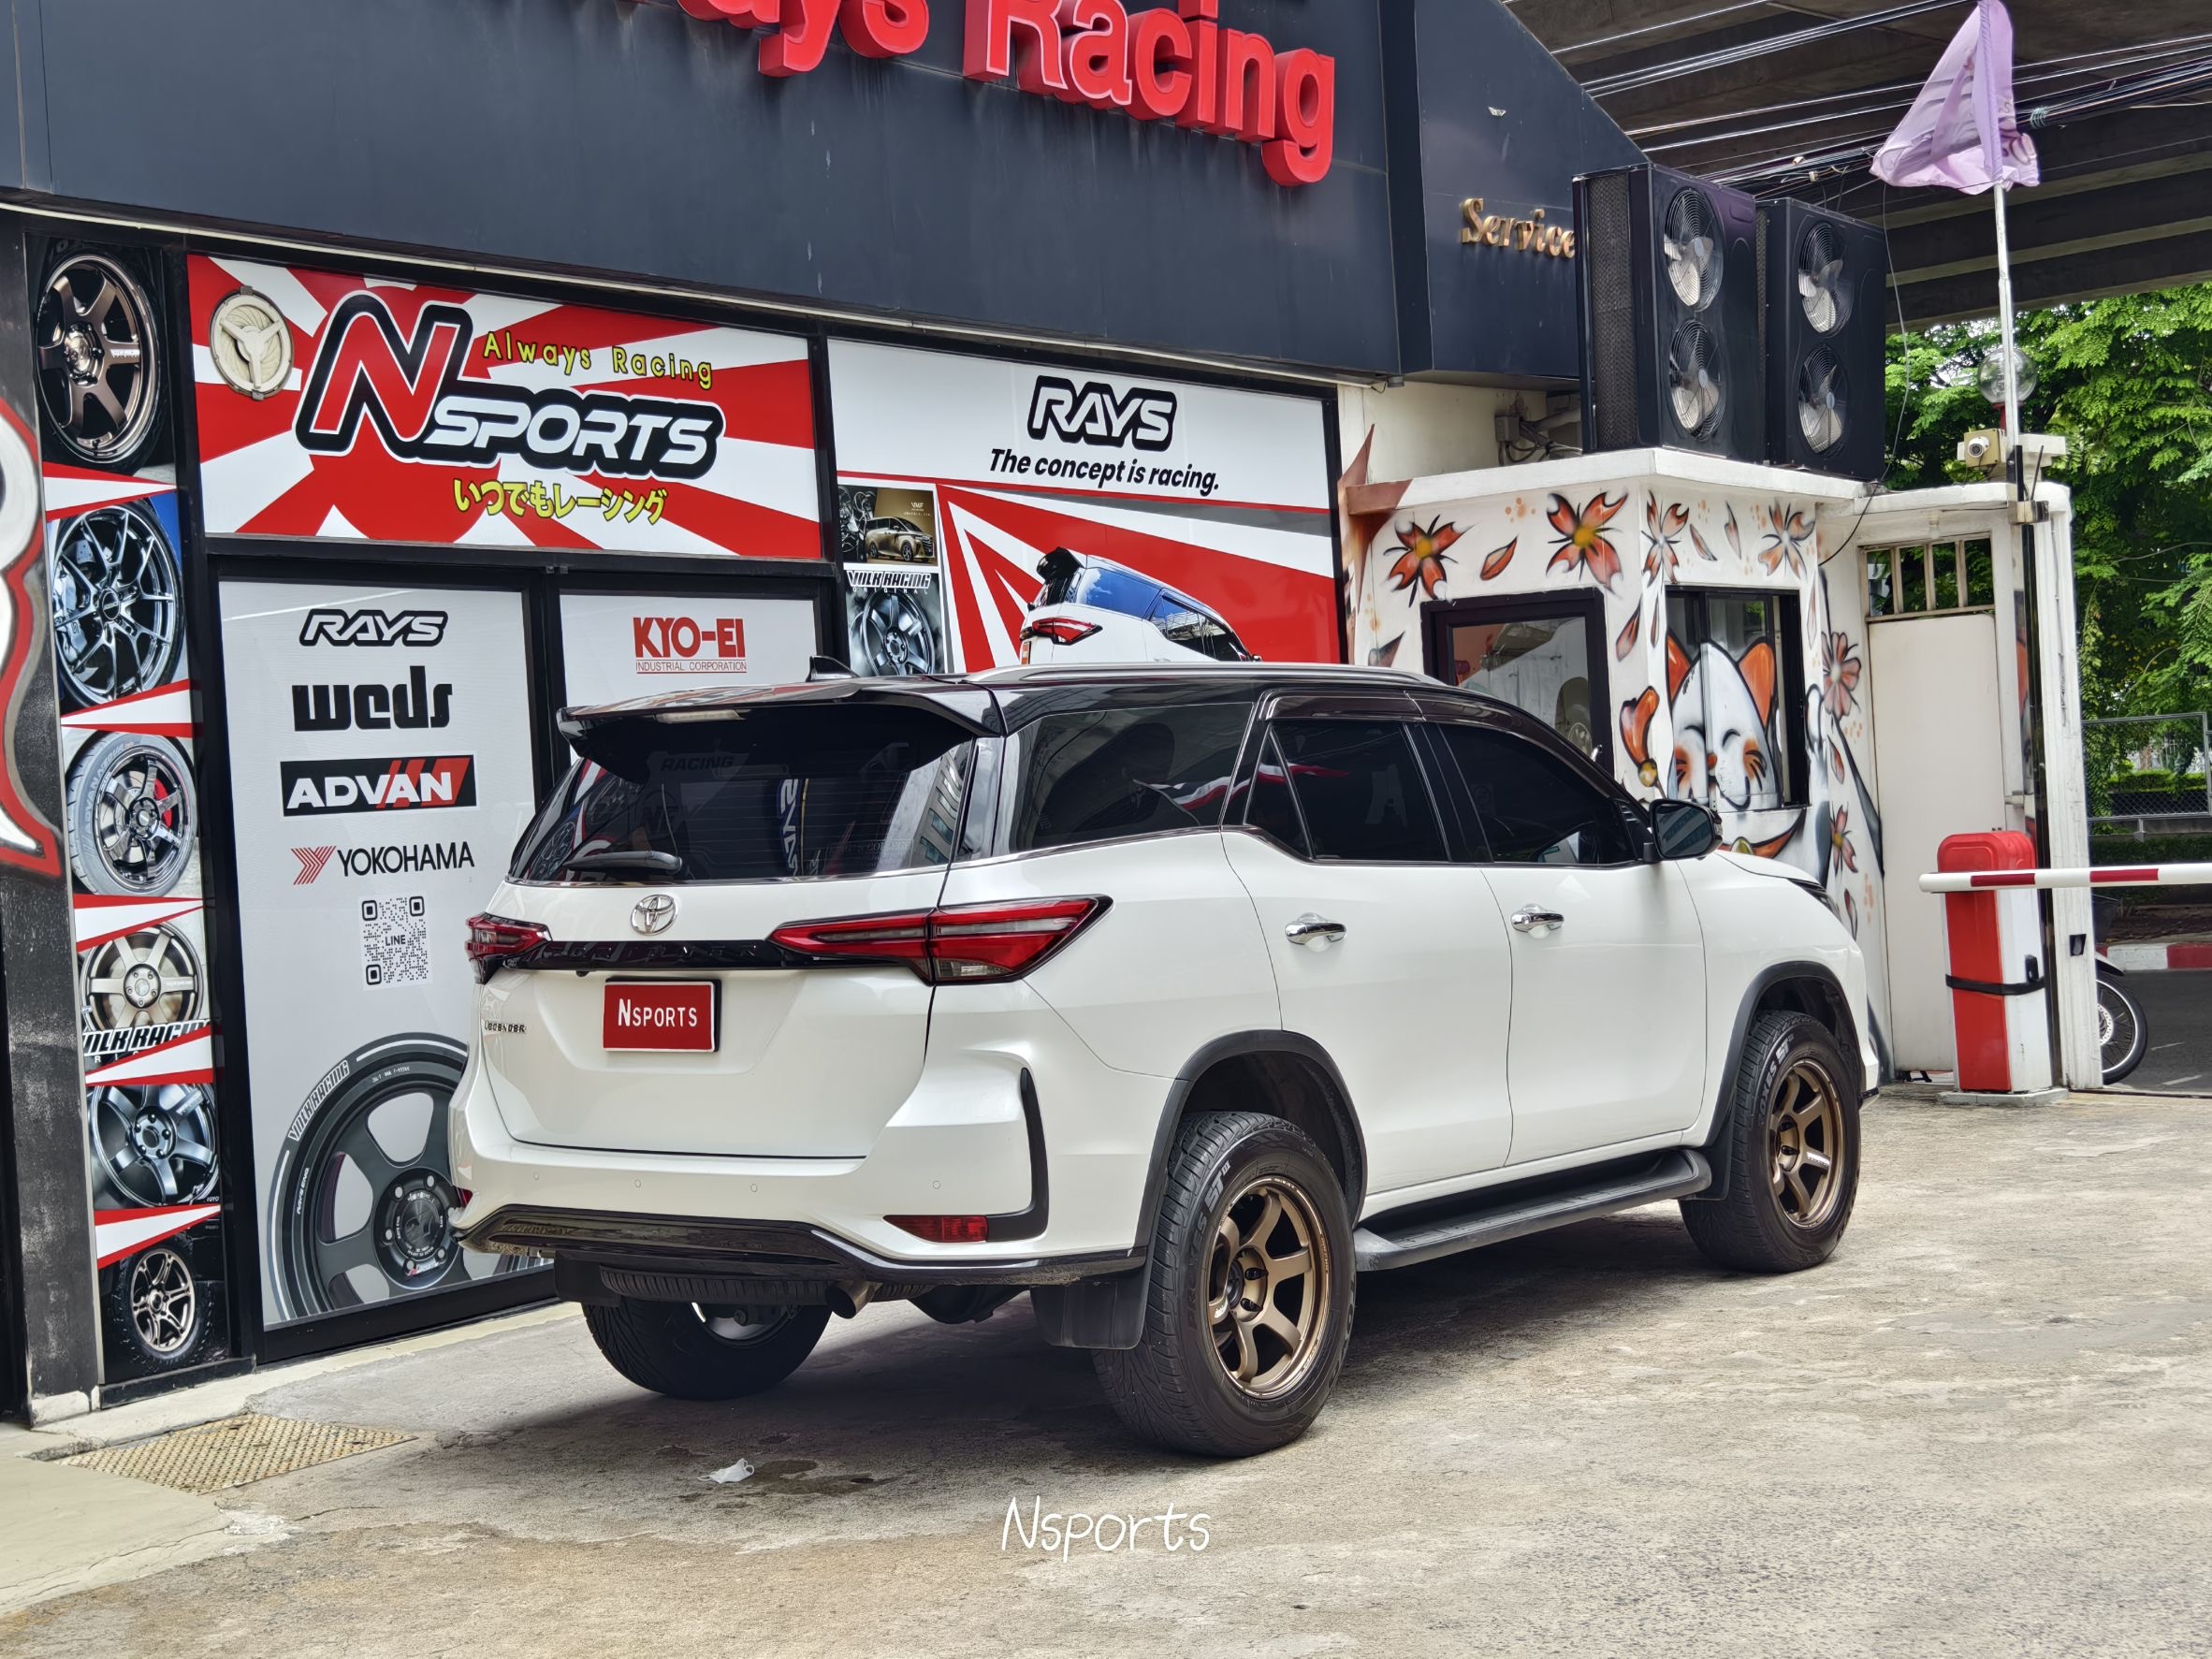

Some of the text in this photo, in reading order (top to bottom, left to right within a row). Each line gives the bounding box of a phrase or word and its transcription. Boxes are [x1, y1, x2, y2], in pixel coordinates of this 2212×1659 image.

[963, 0, 1335, 187] Racing
[1459, 197, 1576, 258] Service
[483, 330, 714, 391] Always Racing
[1027, 375, 1178, 452] RAYS
[988, 448, 1220, 497] The concept is racing.
[452, 477, 669, 526] いつでもレーシング
[299, 609, 449, 648] RAYS
[633, 617, 746, 658] KYO-EI
[635, 661, 748, 672] INDUSTRIAL CORPORATION
[291, 665, 453, 733] weds
[285, 771, 454, 810] ADVAN
[337, 841, 475, 878] YOKOHAMA
[386, 936, 406, 946] LINE
[618, 997, 698, 1027] NSPORTS
